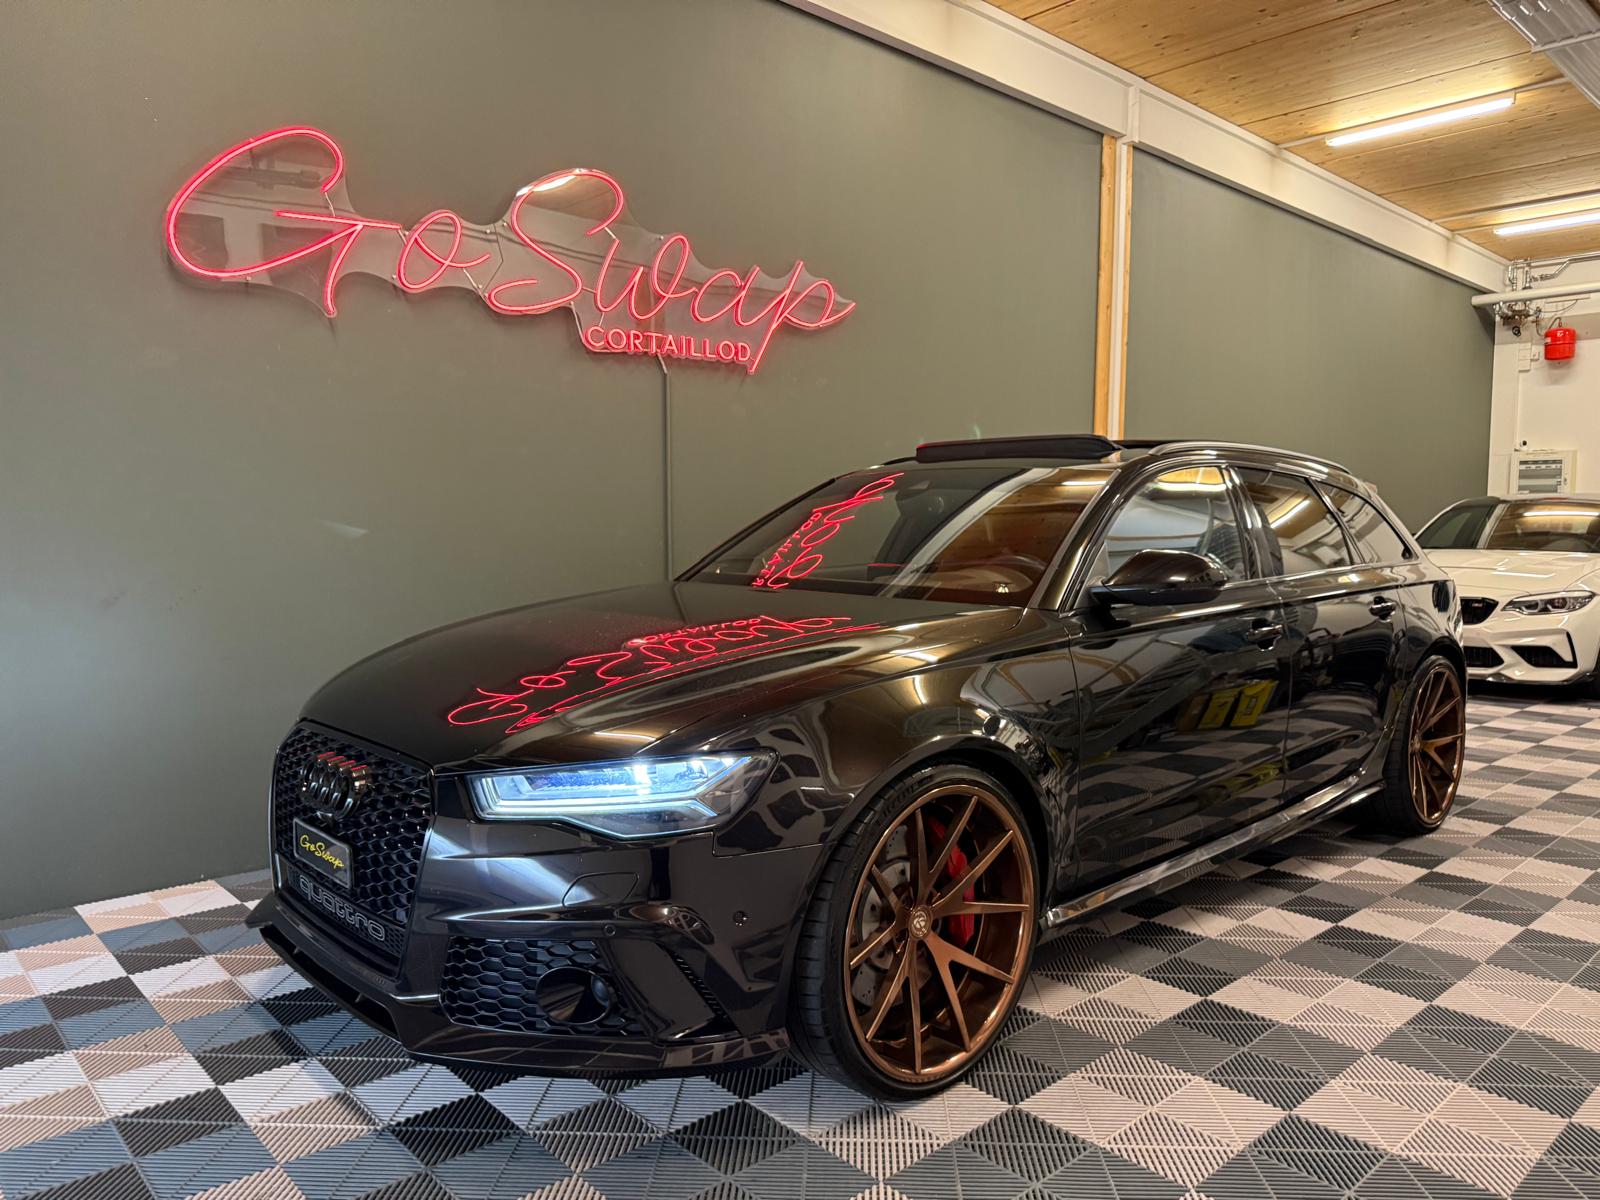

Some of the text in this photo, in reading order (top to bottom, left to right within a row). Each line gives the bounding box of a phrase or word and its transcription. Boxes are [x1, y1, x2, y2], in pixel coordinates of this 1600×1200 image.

[584, 325, 753, 364] CORTAILLOD
[299, 834, 345, 869] GoSwap
[299, 876, 386, 941] quattro
